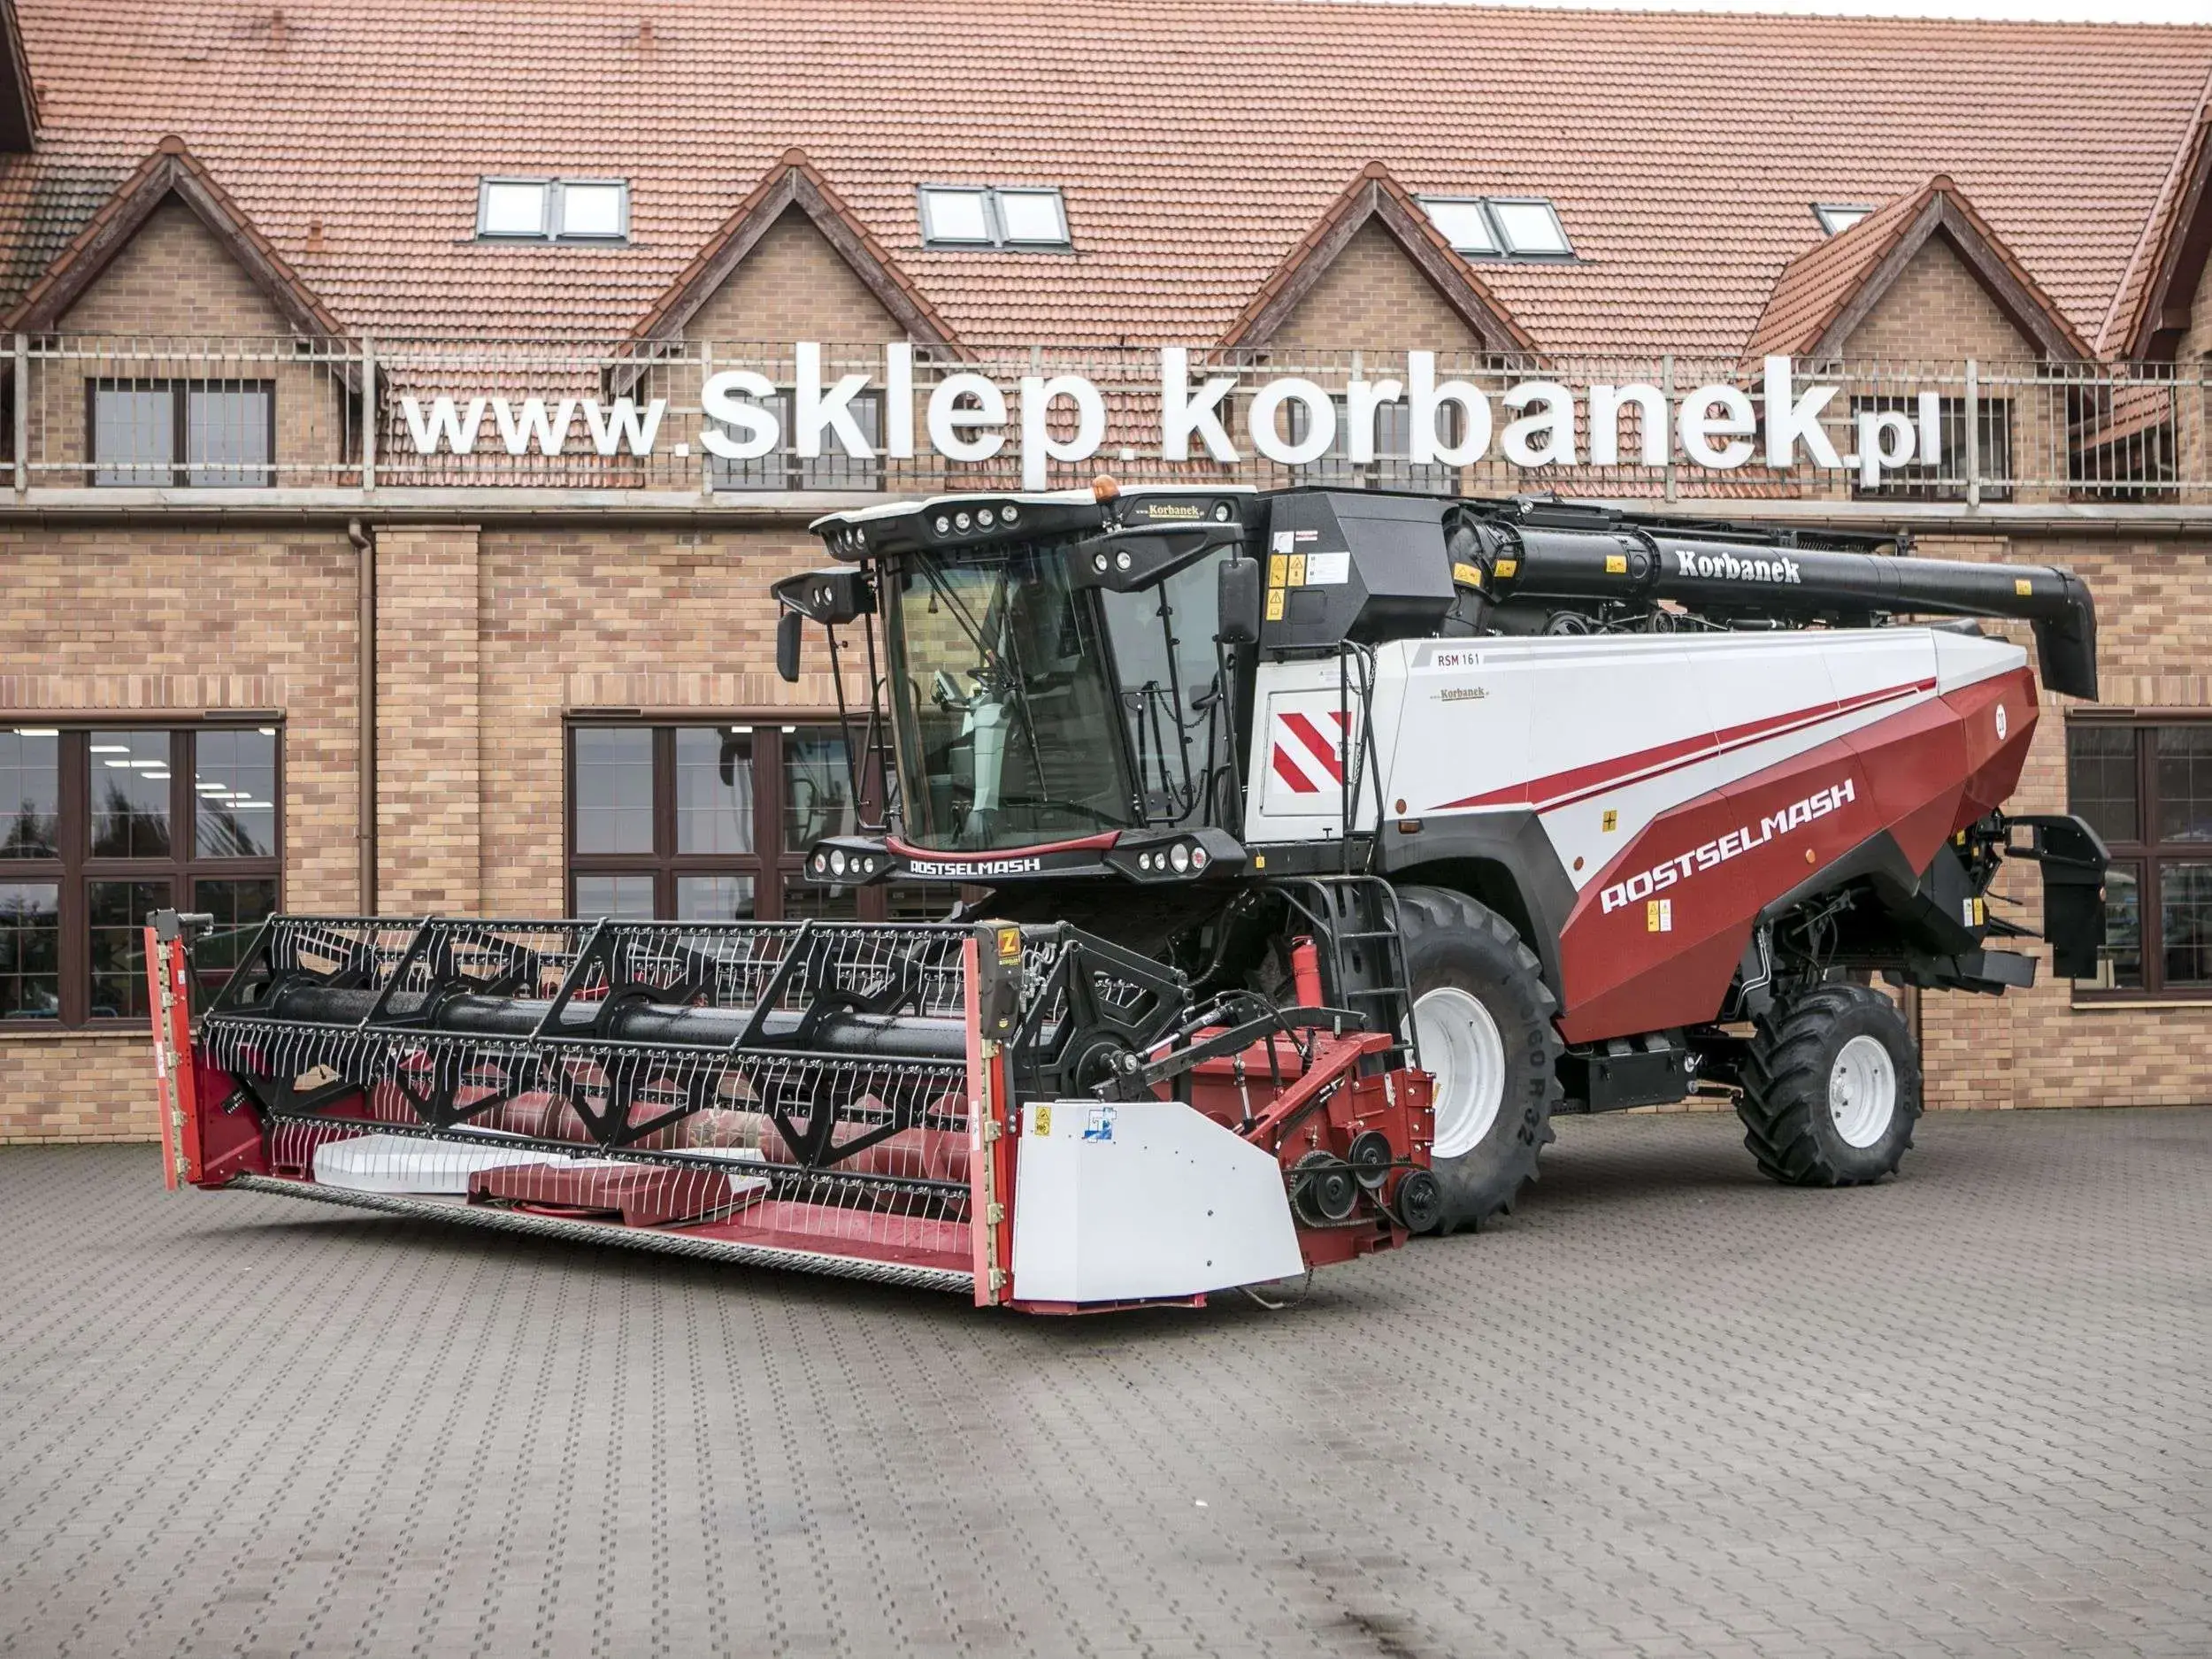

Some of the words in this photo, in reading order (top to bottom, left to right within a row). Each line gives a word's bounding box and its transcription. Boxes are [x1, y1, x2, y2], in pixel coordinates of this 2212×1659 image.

[1676, 550, 1801, 583] Korbanek
[1438, 655, 1459, 666] RSM
[1463, 653, 1479, 665] 161
[1600, 778, 1855, 914] ROSTSELMASH
[910, 858, 1041, 875] ROSTSELMASH
